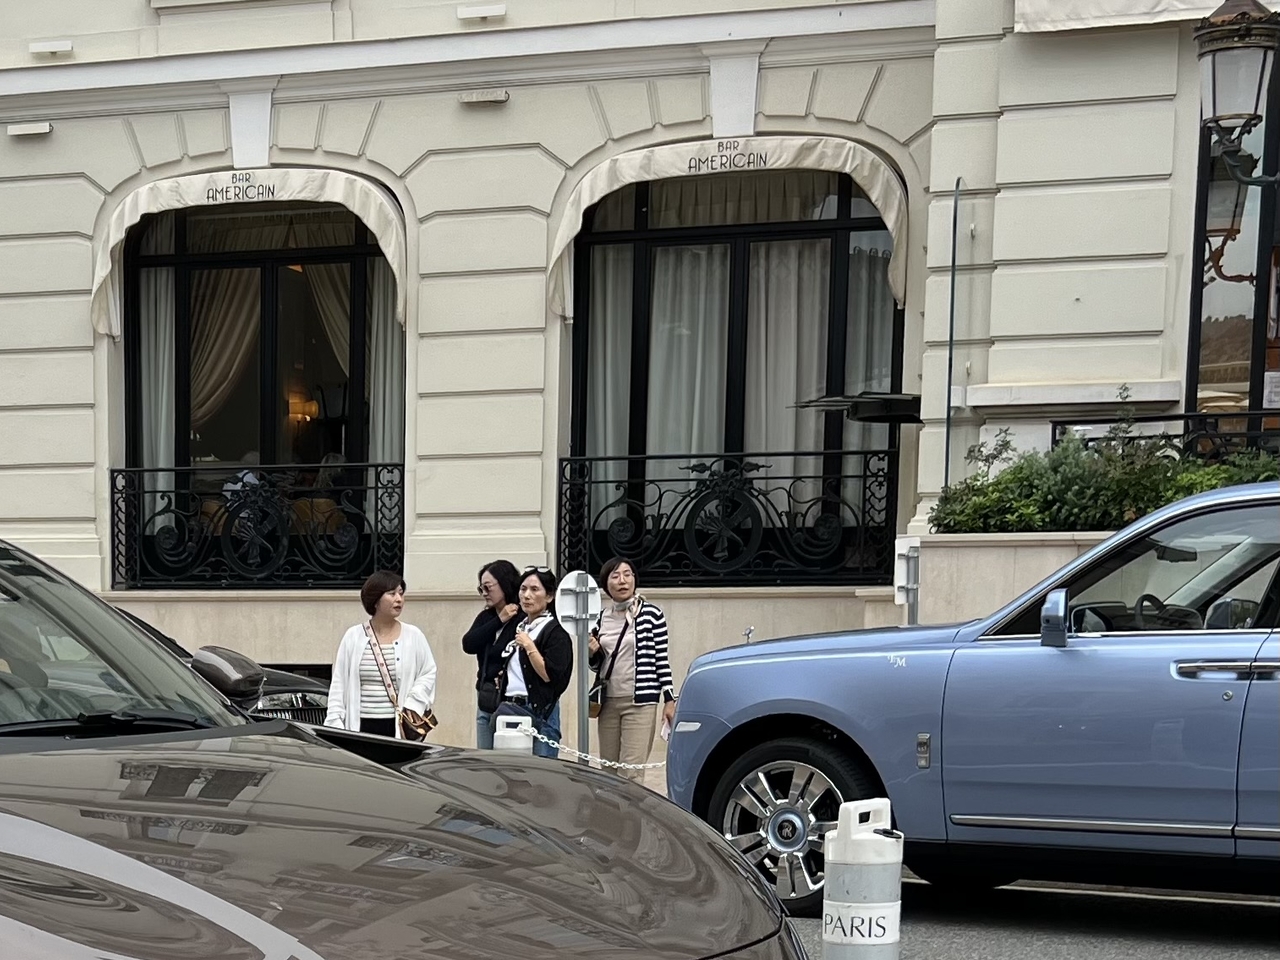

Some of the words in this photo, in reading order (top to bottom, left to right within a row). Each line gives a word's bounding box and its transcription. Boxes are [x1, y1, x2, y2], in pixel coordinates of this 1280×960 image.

[718, 140, 739, 152] BAR
[688, 152, 768, 172] AMERICAIN
[231, 172, 251, 184] BAR
[206, 184, 275, 202] AMERICAIN
[824, 913, 887, 938] PARIS
